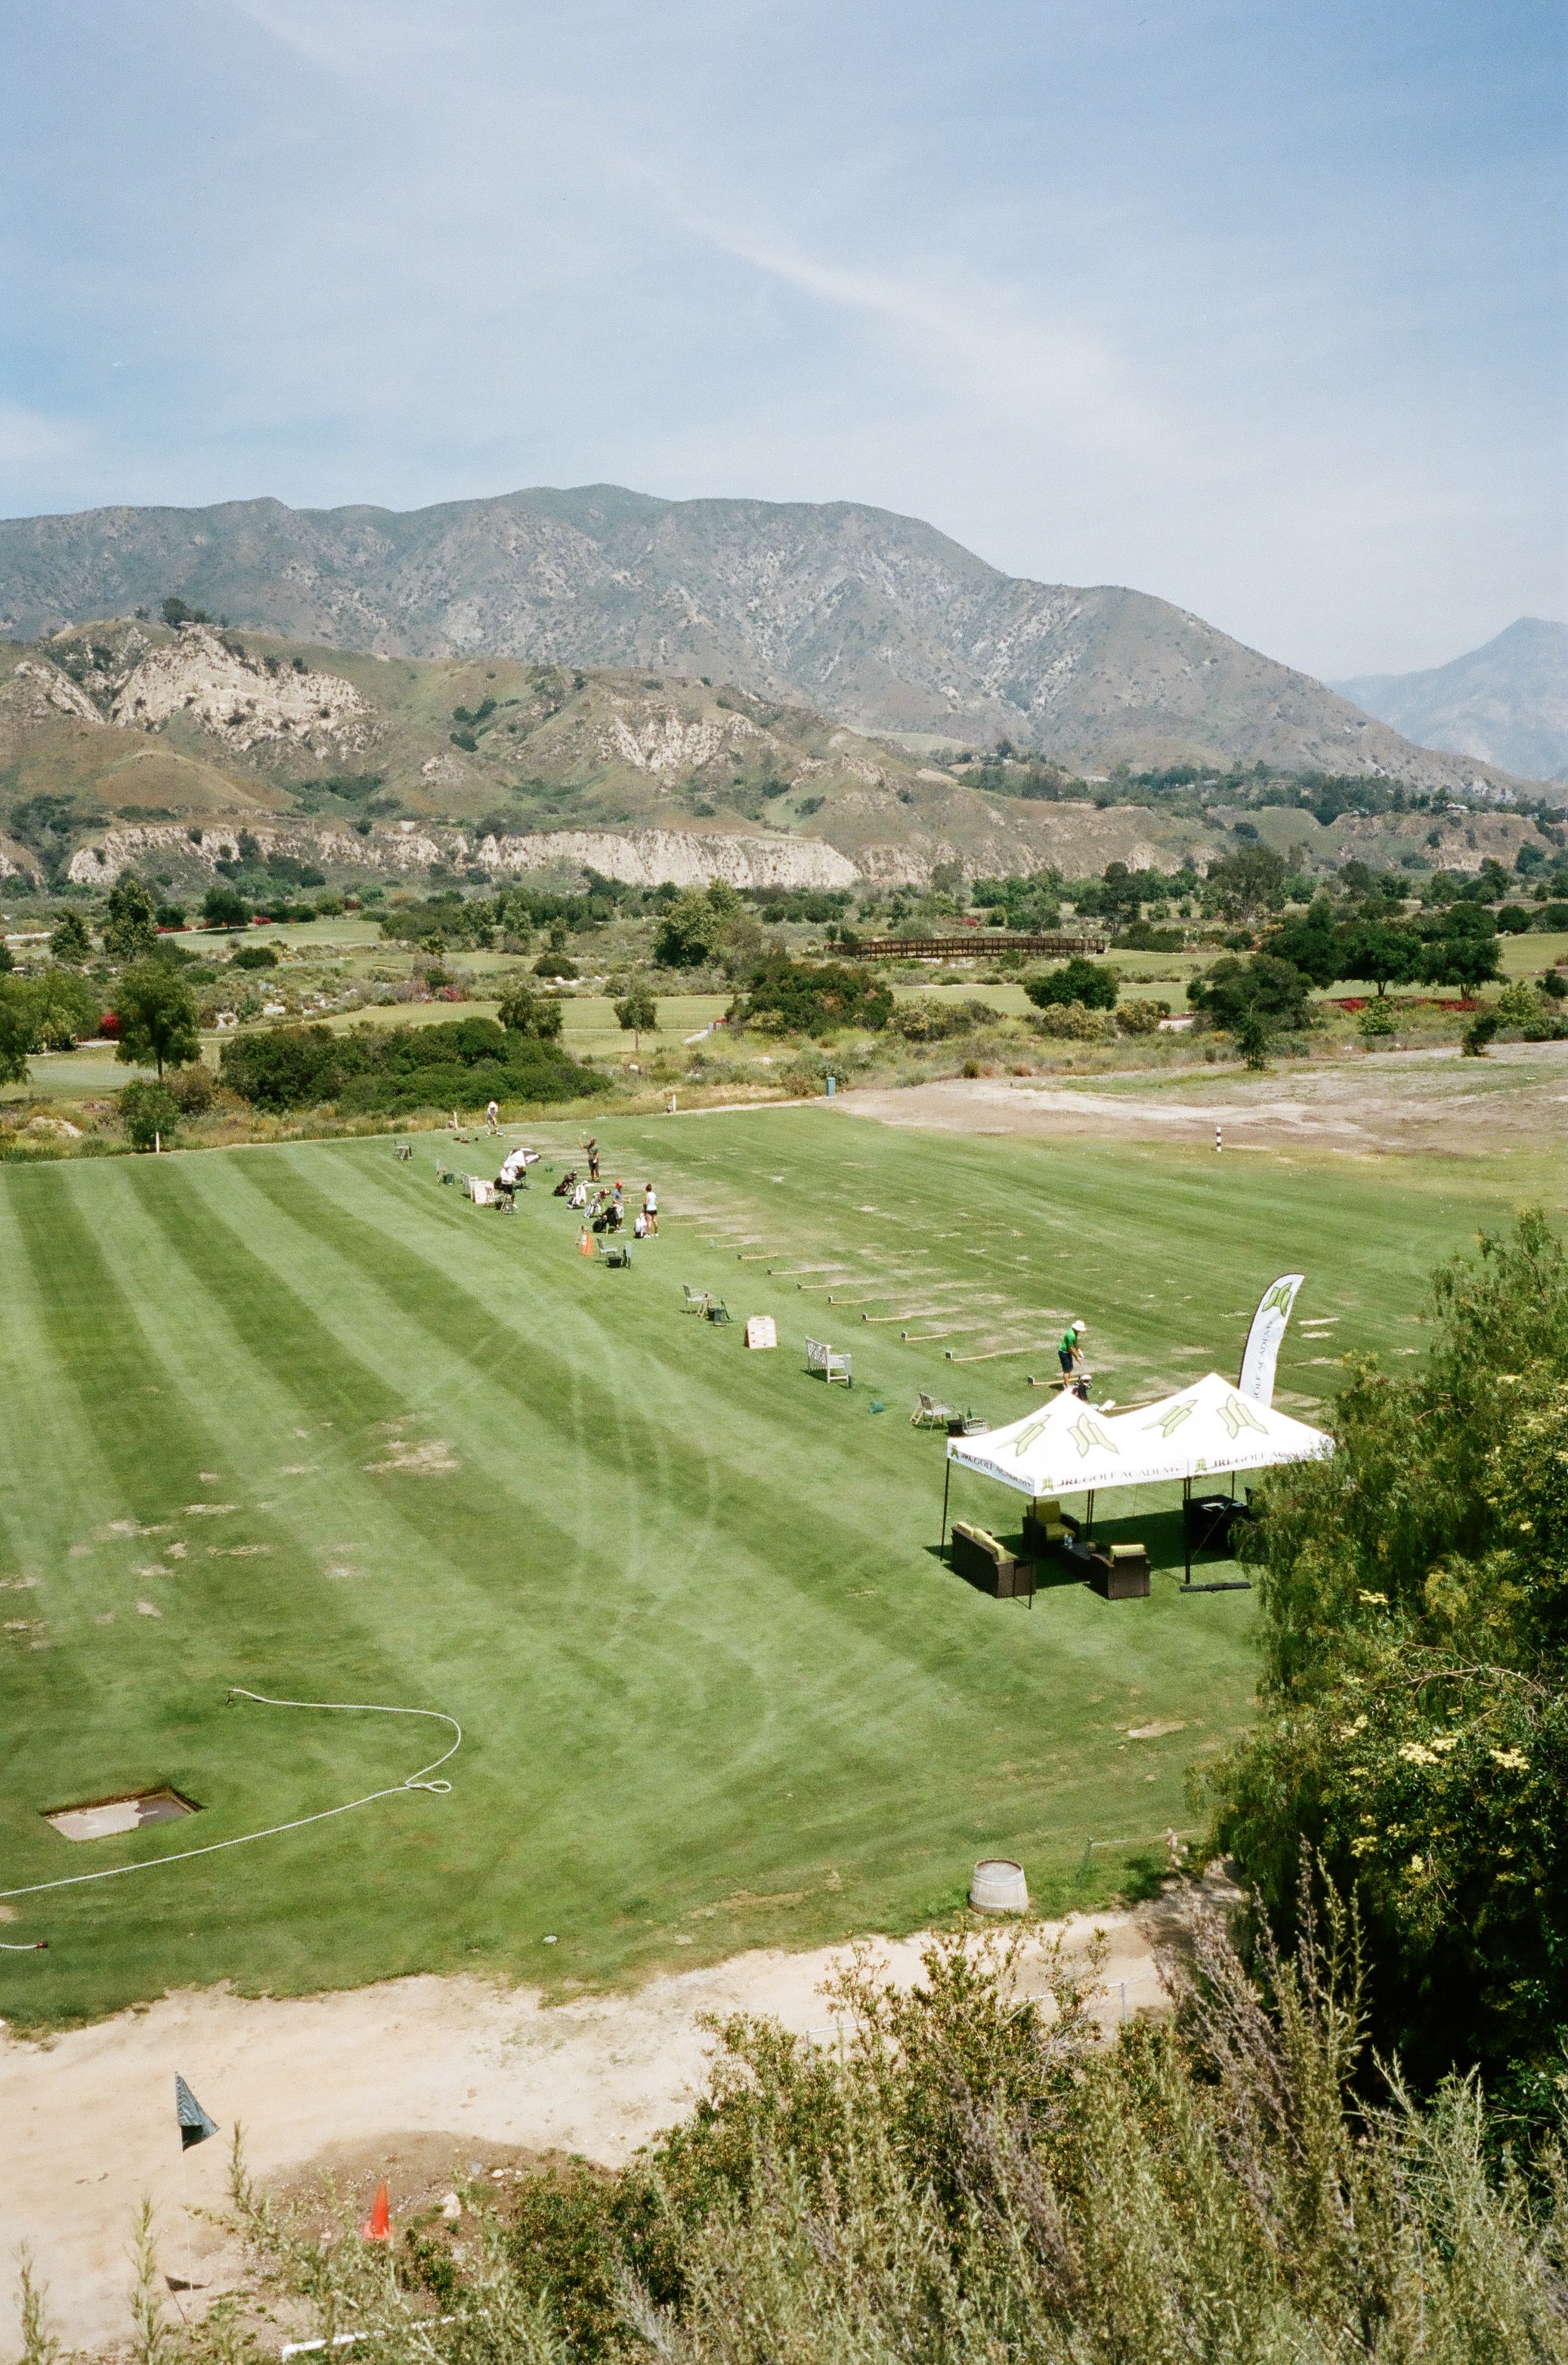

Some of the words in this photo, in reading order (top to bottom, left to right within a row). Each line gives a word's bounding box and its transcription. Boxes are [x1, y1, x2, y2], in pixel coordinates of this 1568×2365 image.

[974, 1458, 993, 1470] GOLF
[1083, 1471, 1115, 1482] GOLF
[1121, 1466, 1180, 1478] ACADEMY
